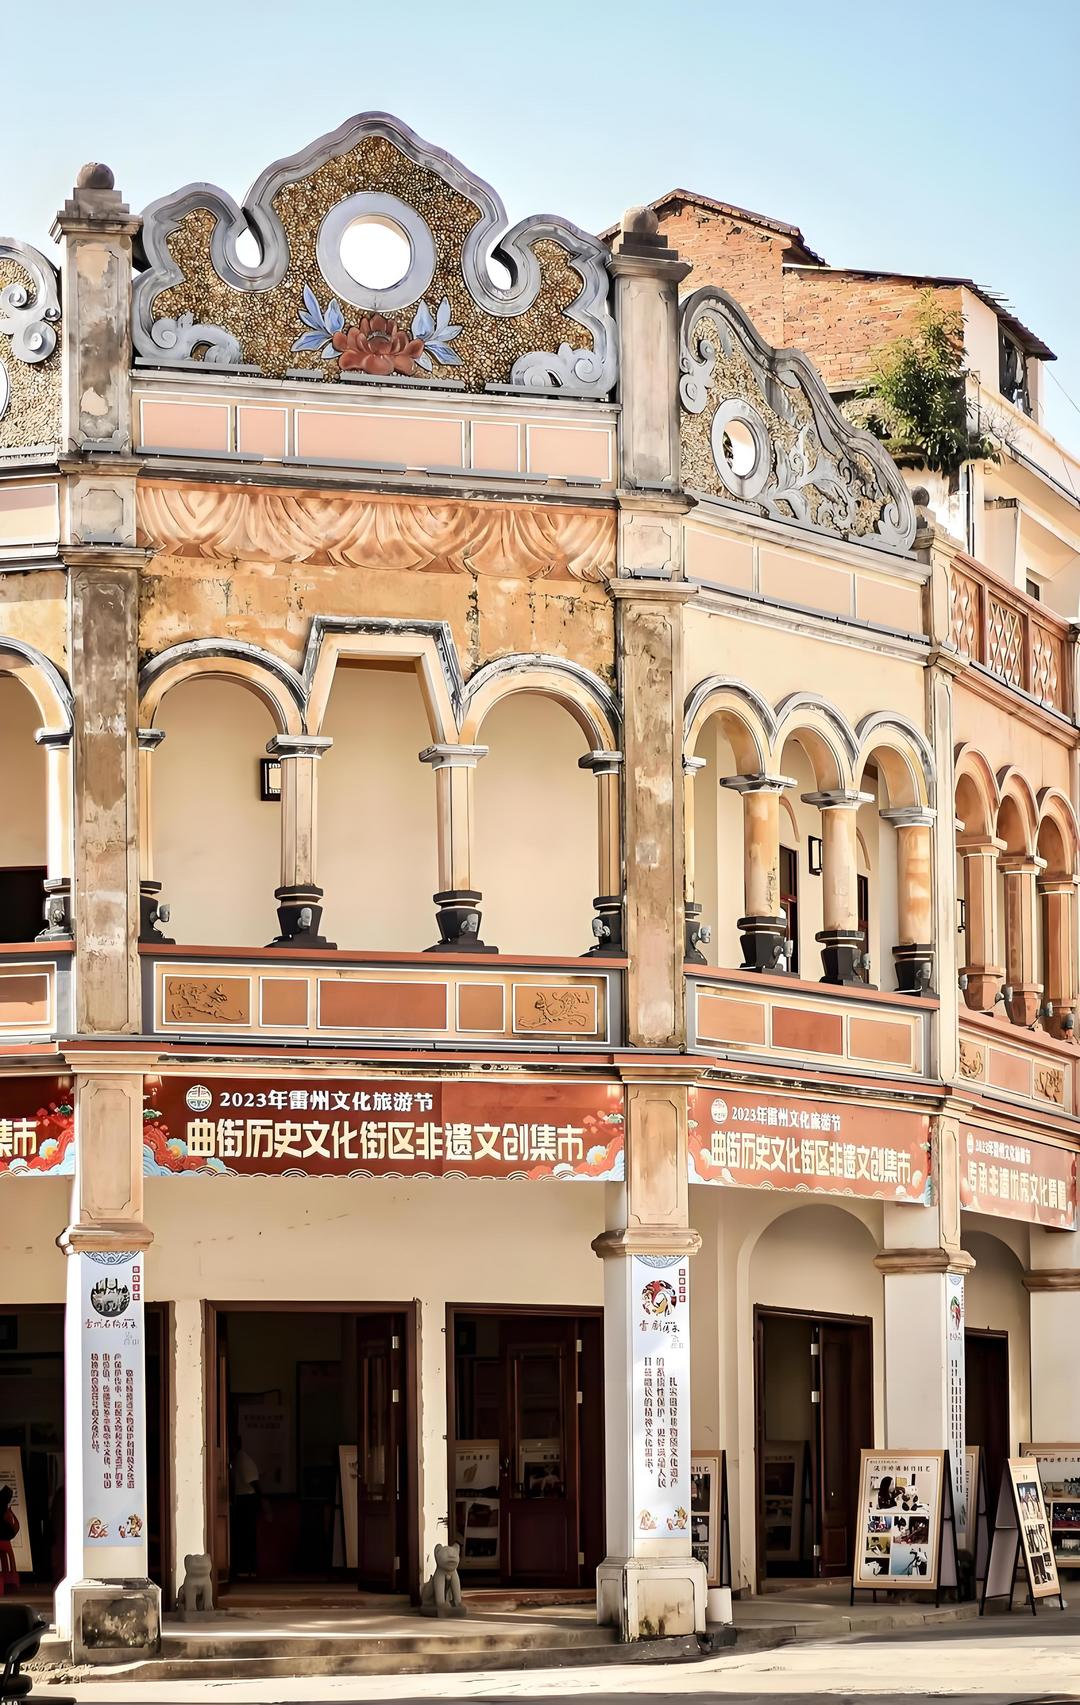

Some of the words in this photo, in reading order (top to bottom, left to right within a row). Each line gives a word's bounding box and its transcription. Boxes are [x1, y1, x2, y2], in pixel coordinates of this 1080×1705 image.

[219, 1089, 433, 1112] 2023年雷州文化旅游节
[731, 1106, 841, 1132] 2023年雷州文化旅游节
[187, 1118, 584, 1161] 曲街历史文化街区非遗文创集市
[711, 1130, 911, 1184] 曲街历史文化街区非遗文创集市
